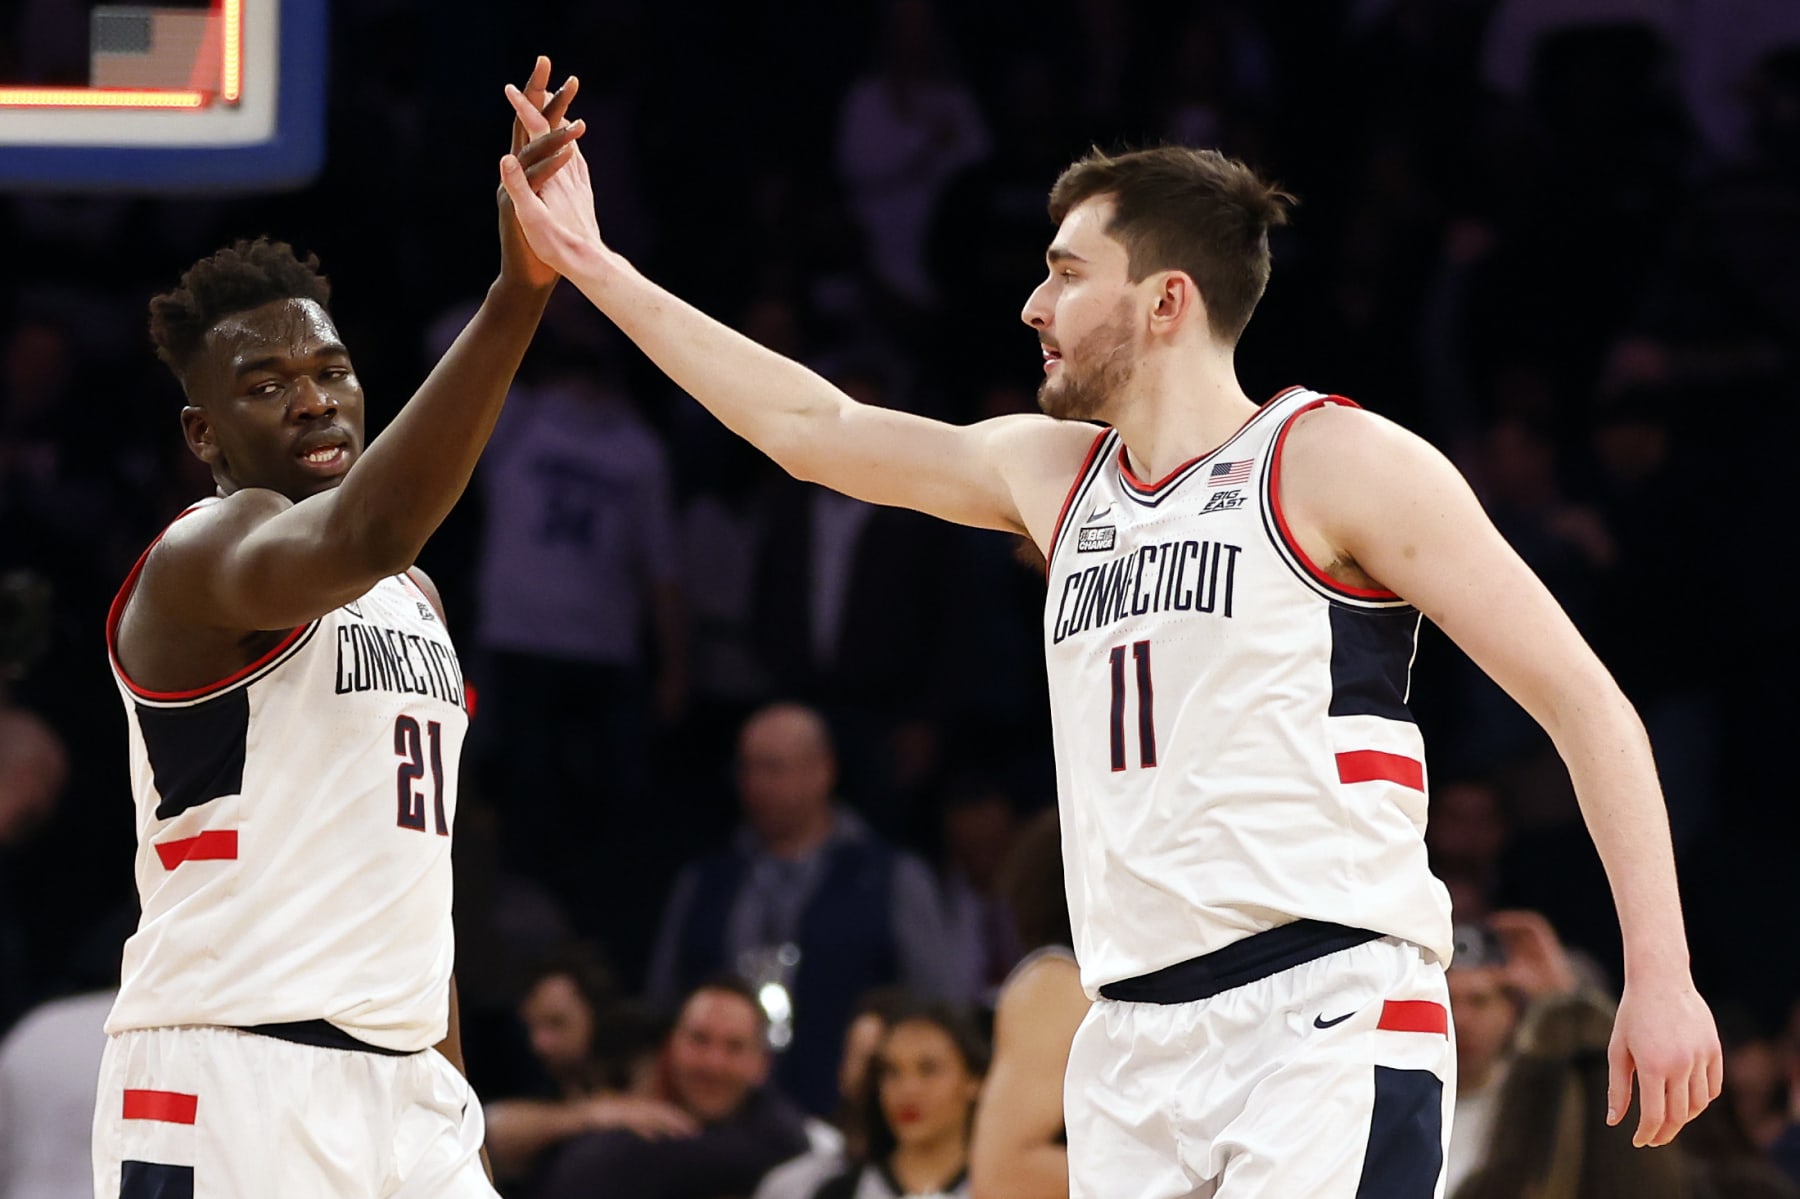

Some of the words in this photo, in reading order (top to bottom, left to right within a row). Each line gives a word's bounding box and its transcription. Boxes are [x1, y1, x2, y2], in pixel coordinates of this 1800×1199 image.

[1203, 497, 1248, 510] EAST
[1210, 489, 1241, 501] BIG
[1079, 540, 1112, 550] CHANGE
[1053, 541, 1242, 645] CONNECTICUT
[335, 624, 467, 711] CONNECTICU
[1109, 640, 1157, 772] 11
[394, 714, 449, 837] 21
